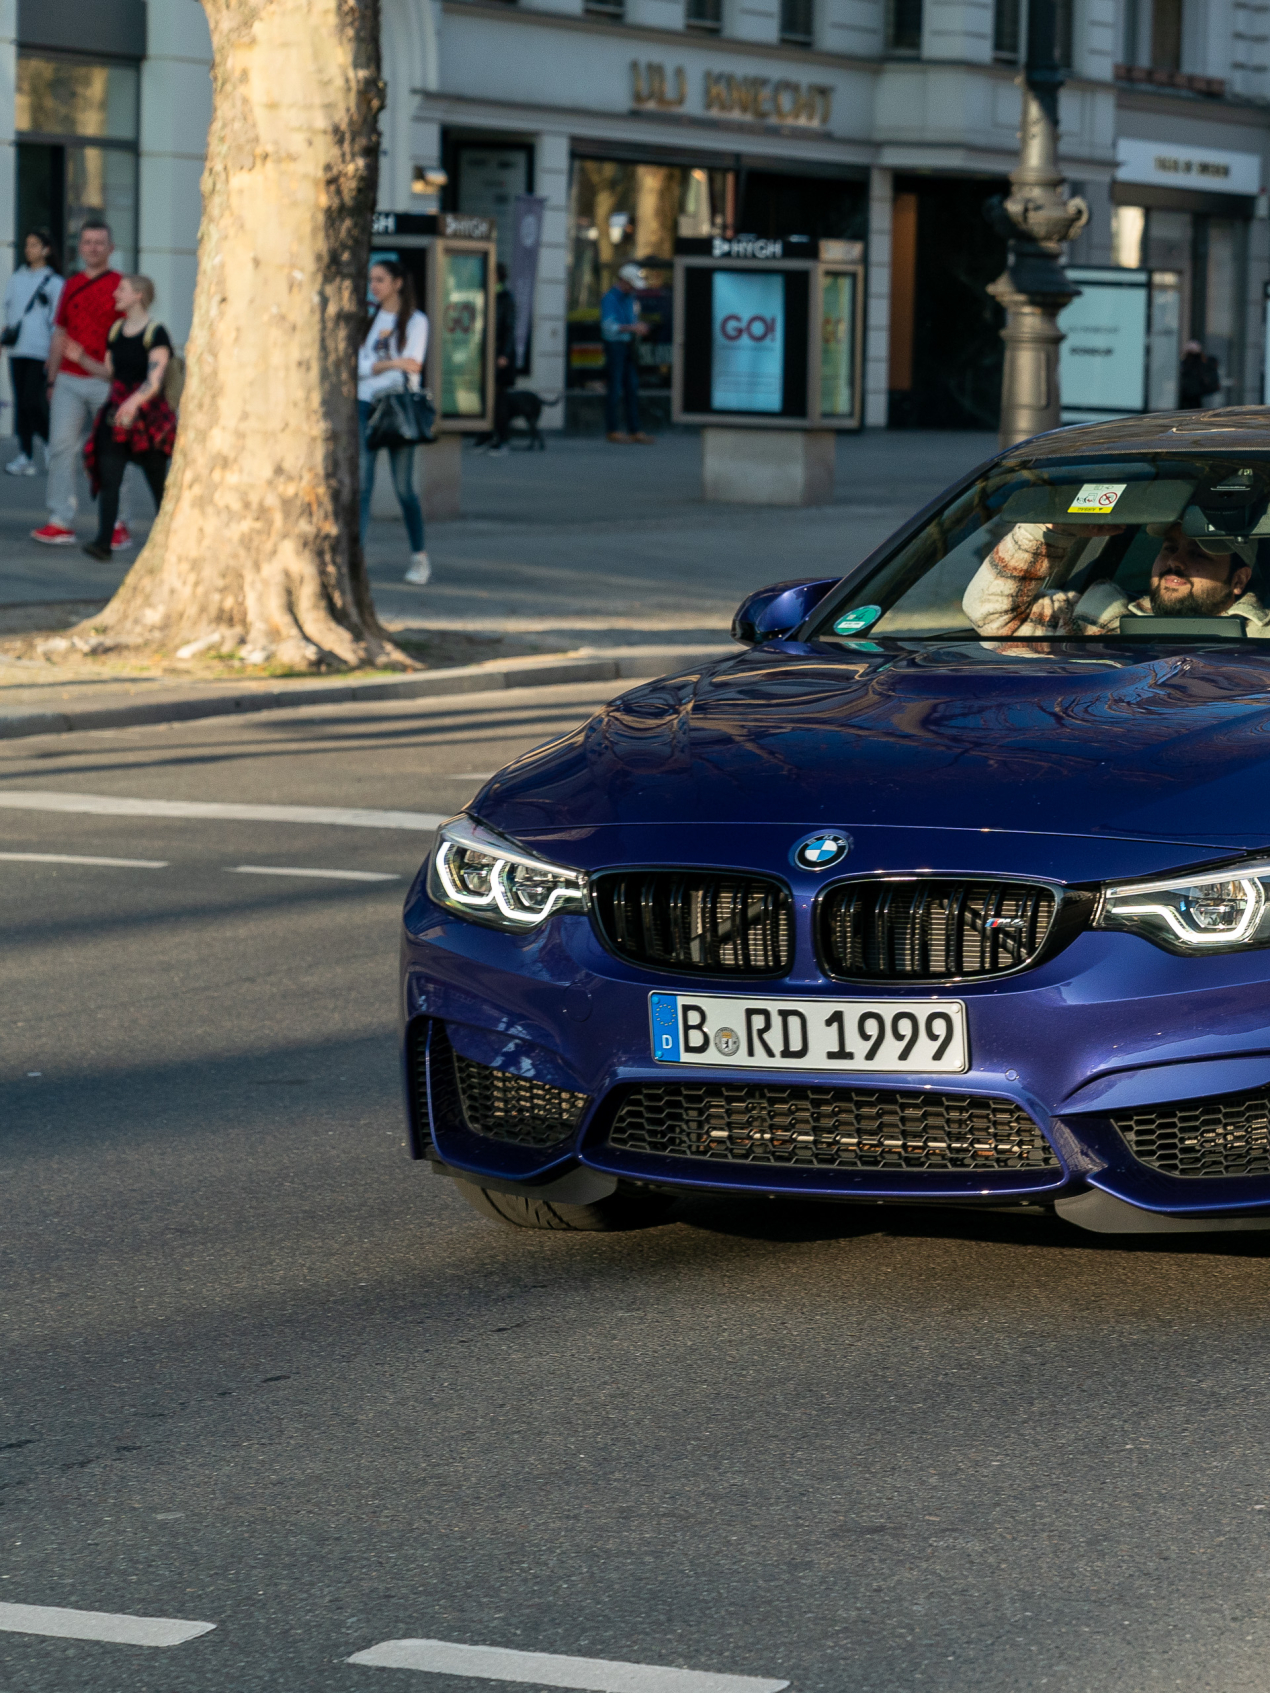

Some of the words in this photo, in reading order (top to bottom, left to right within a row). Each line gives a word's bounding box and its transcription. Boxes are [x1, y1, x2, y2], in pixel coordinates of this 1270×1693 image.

[720, 314, 777, 343] GO!
[661, 1034, 673, 1049] D
[681, 1003, 710, 1054] B
[745, 1007, 809, 1059] RD
[825, 1010, 954, 1061] 1999
